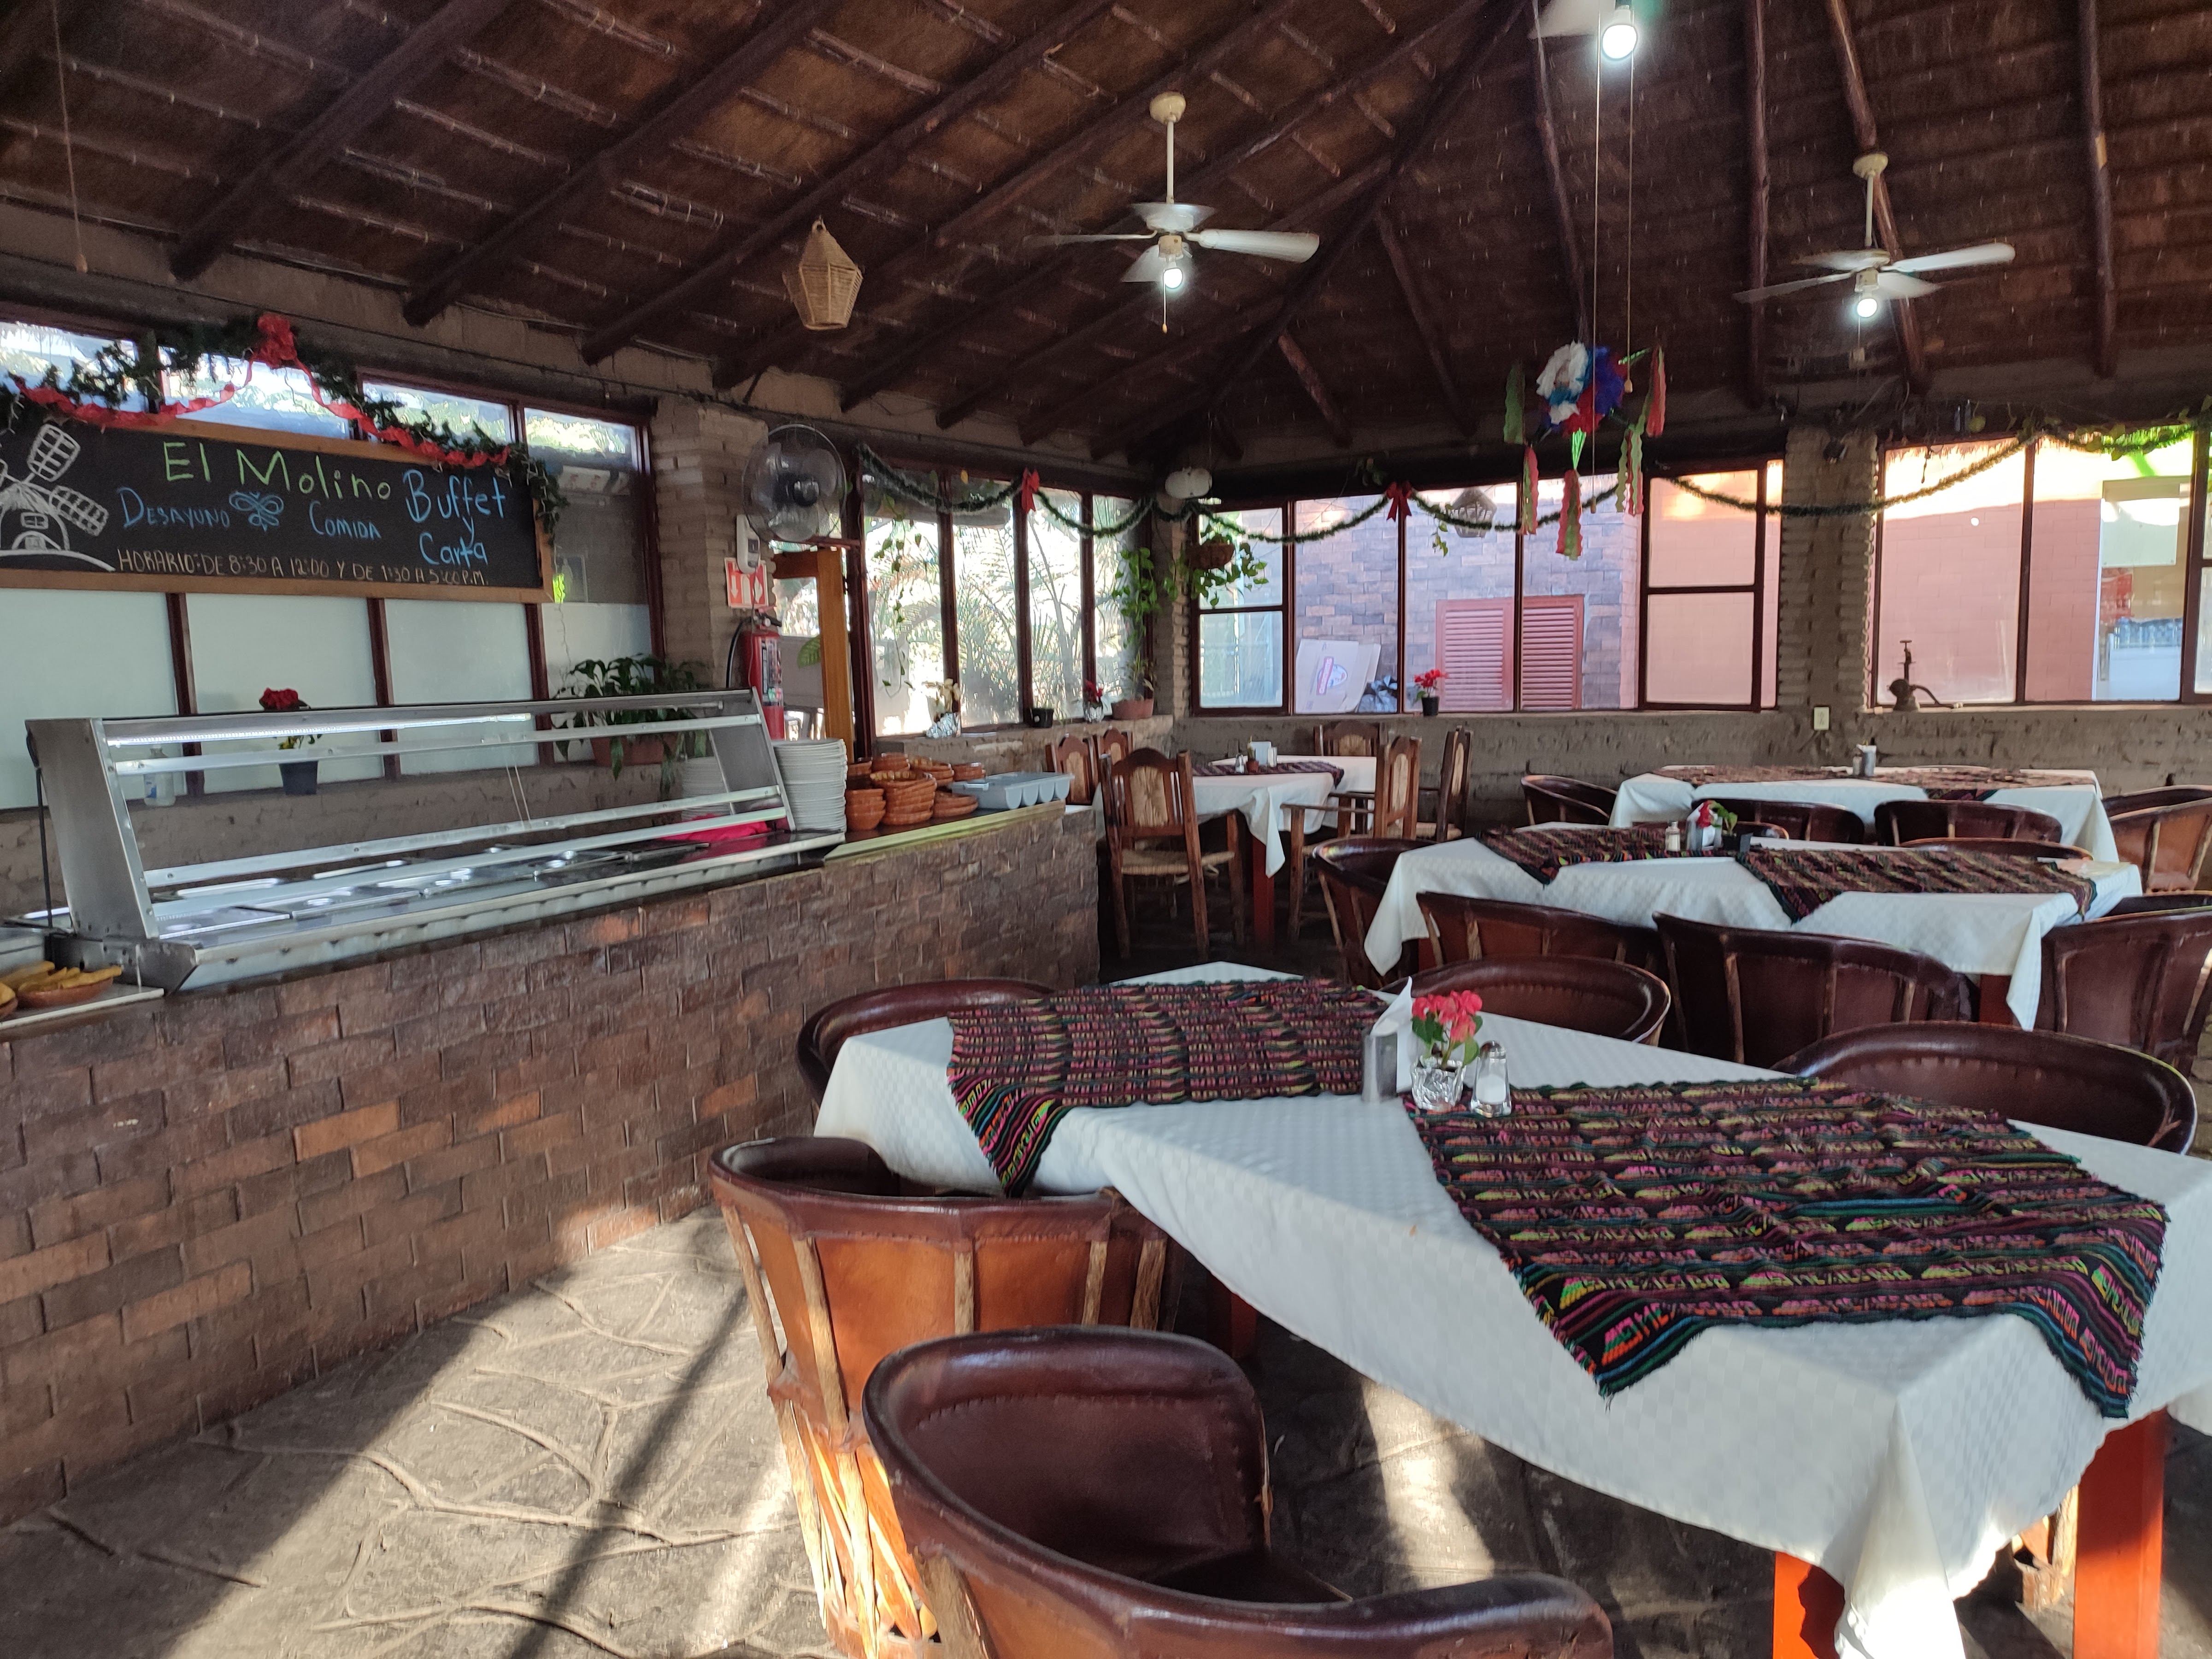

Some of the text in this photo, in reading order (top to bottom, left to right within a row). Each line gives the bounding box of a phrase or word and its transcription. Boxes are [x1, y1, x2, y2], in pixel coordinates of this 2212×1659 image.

[163, 441, 391, 500] El Molino
[402, 469, 506, 524] Buffet
[229, 554, 267, 575] 8:30
[271, 556, 284, 577] A
[290, 557, 329, 578] 12:00
[336, 560, 346, 579] Y
[352, 562, 374, 582] DE
[415, 567, 425, 583] A
[419, 531, 488, 569] Carta
